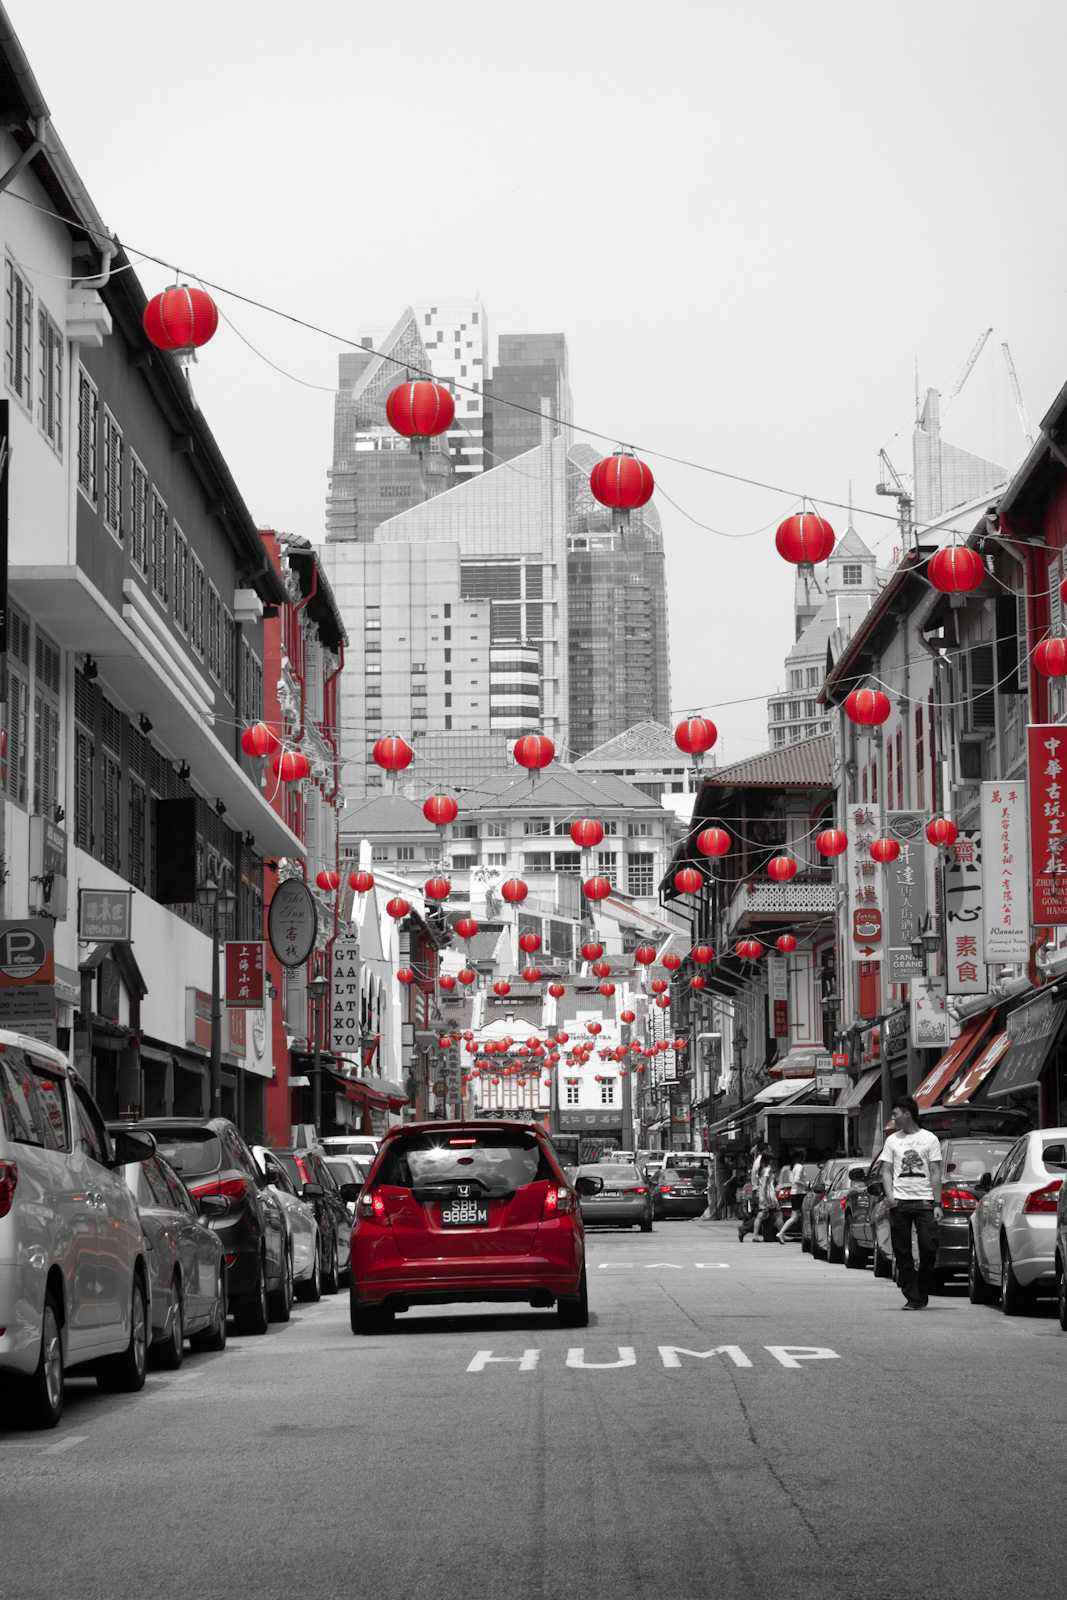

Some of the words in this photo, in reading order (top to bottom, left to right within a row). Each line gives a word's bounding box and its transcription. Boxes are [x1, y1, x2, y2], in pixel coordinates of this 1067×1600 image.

[990, 927, 1024, 935] Wannian
[6, 932, 36, 965] P
[334, 950, 345, 1046] GALAXY
[345, 950, 357, 1046] TATTOO
[215, 1088, 220, 1098] 8
[452, 1200, 477, 1210] SBH
[466, 1345, 841, 1373] HUMP
